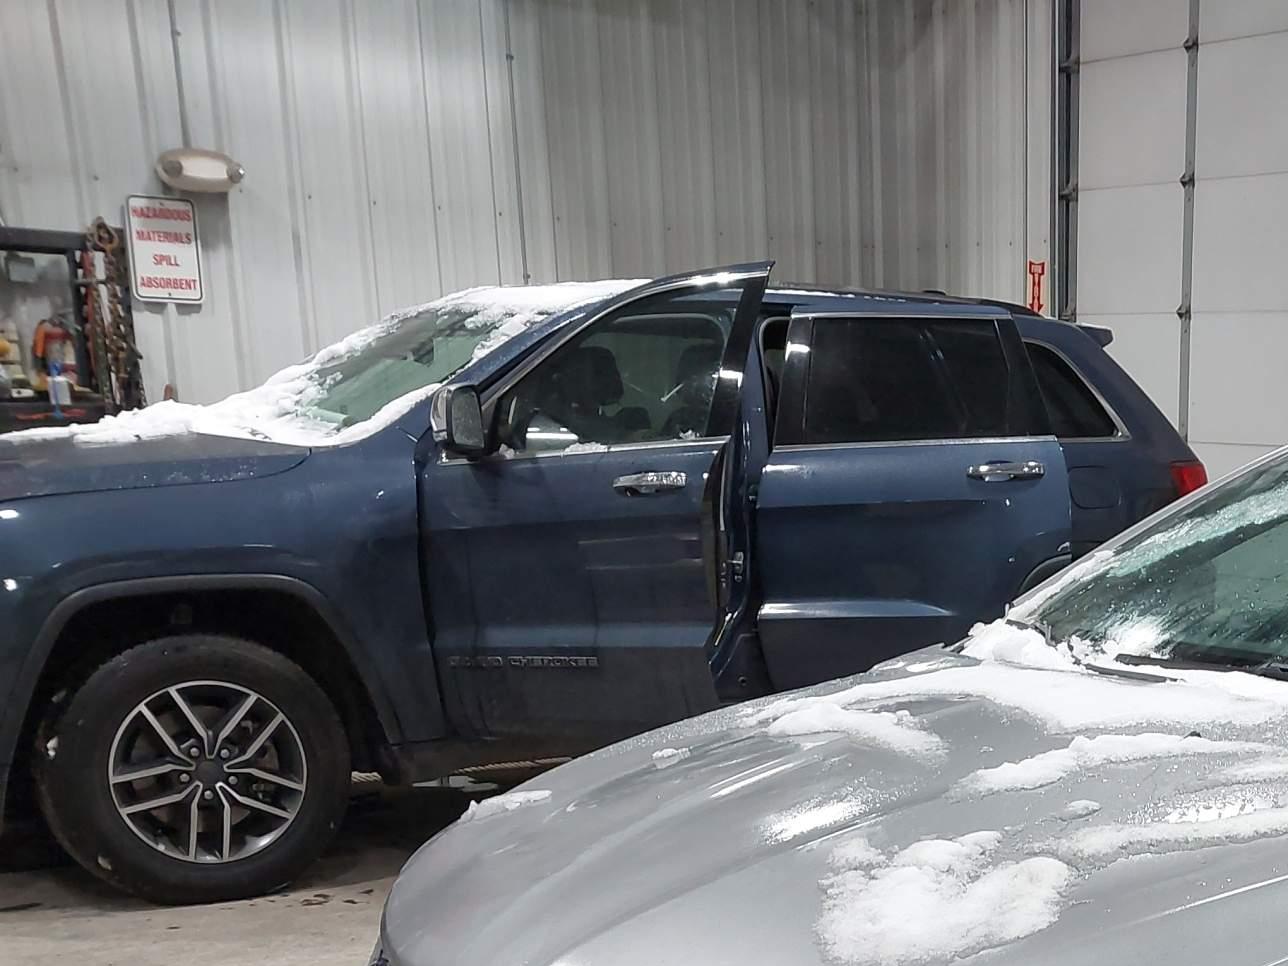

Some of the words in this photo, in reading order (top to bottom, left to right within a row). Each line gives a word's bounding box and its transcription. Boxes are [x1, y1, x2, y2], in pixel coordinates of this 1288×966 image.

[131, 206, 192, 222] HAZARDOUS
[136, 229, 192, 245] MATERIALS
[152, 254, 180, 267] SPILL
[141, 275, 197, 291] ABSORBENT
